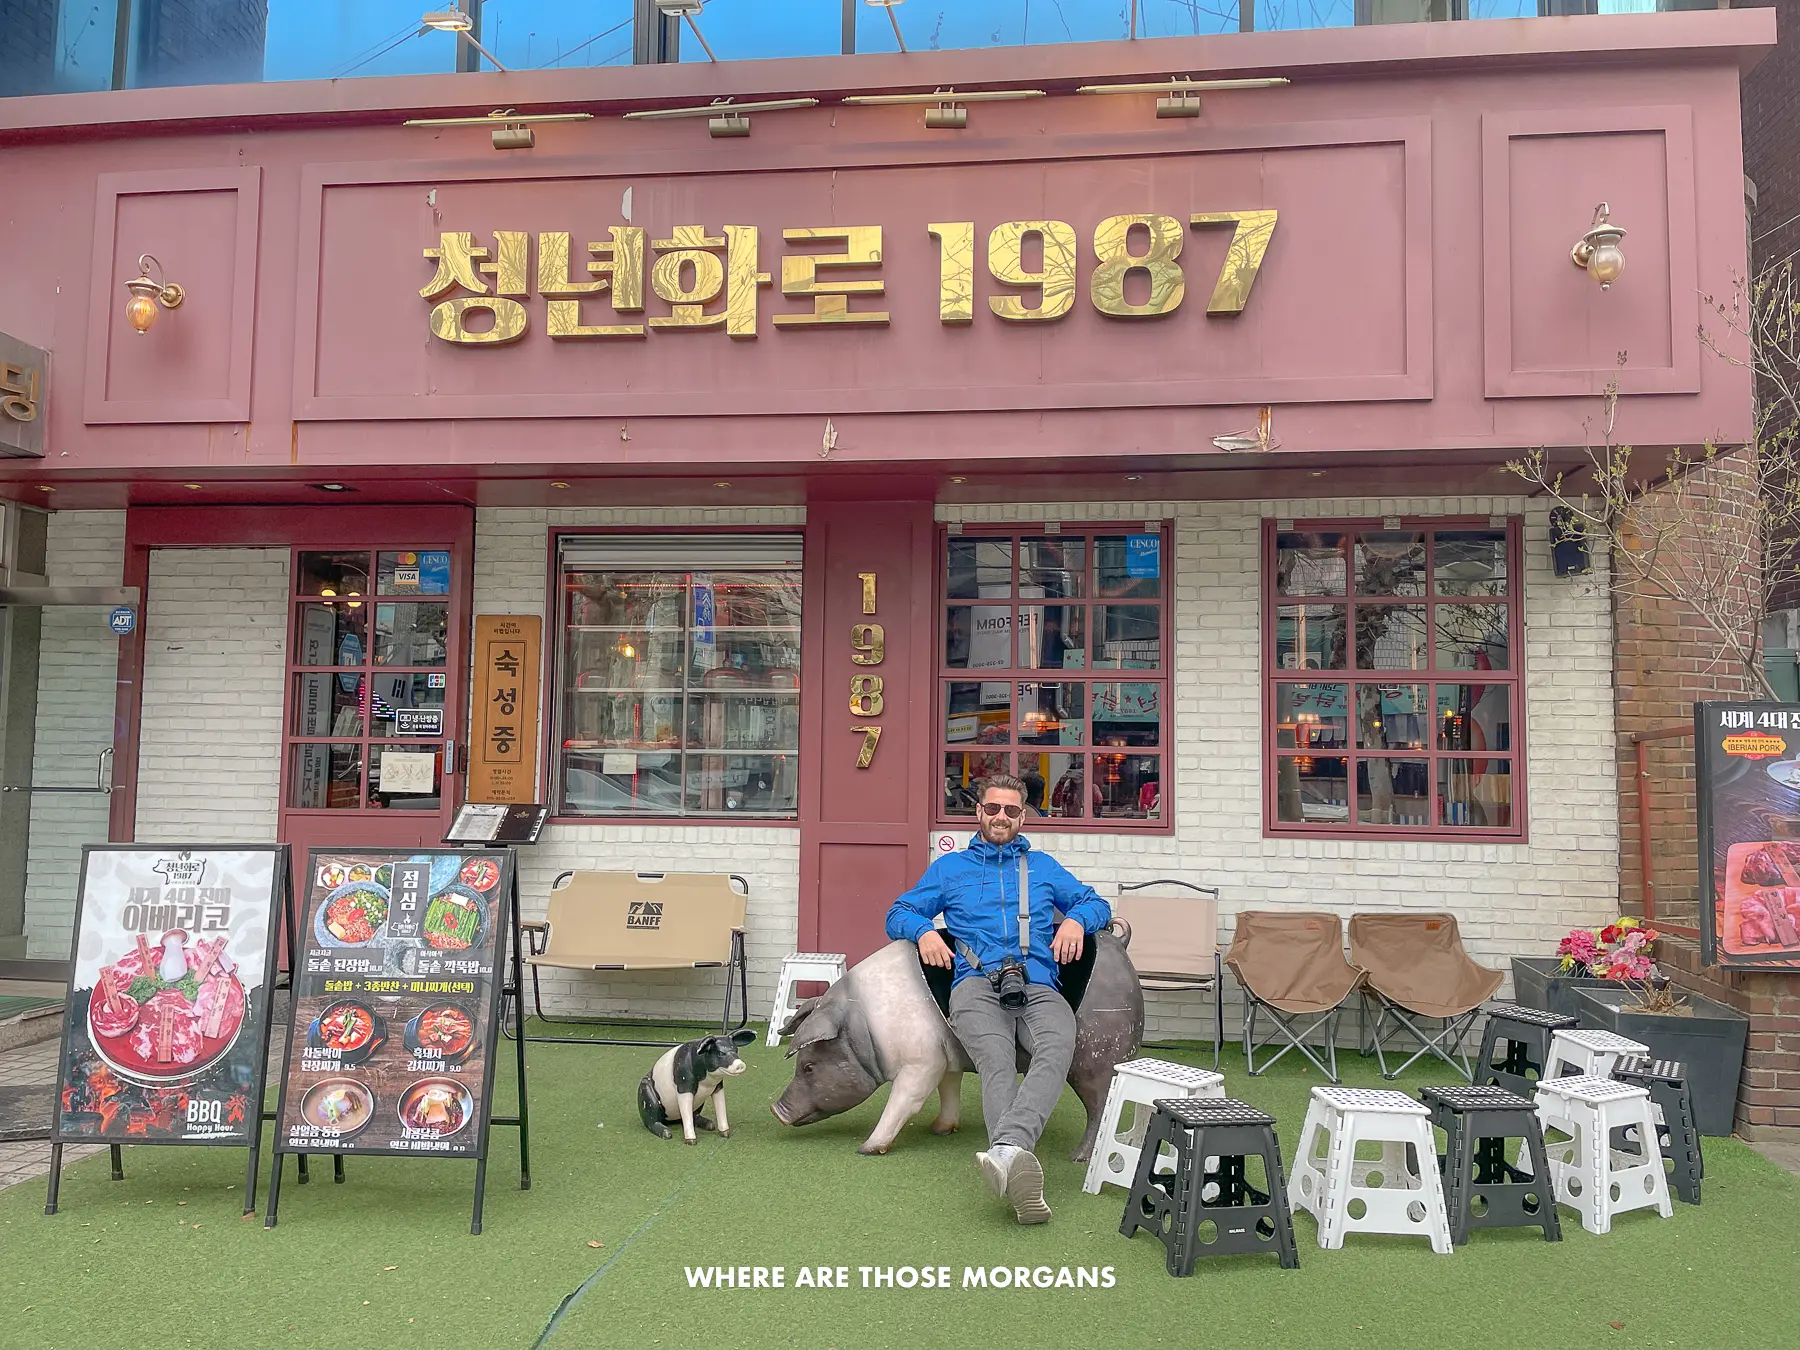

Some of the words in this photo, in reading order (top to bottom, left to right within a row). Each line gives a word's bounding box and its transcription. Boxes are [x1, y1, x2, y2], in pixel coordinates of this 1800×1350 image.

[418, 224, 890, 345] 청년화로
[929, 209, 1278, 324] 1987
[1130, 539, 1157, 549] CESCO
[423, 555, 448, 565] CESCO
[112, 615, 132, 626] ADT
[849, 572, 885, 769] 1987
[491, 650, 520, 754] 숙성중
[1719, 711, 1754, 729] 세계
[1756, 712, 1788, 729] 4대
[1759, 744, 1781, 752] PORK
[173, 872, 193, 880] 1987
[400, 870, 420, 911] 점심
[122, 904, 230, 933] 이베리코
[627, 915, 662, 925] BANFF
[334, 958, 370, 973] 된장밥
[301, 1060, 341, 1072] 된장찌개
[407, 1060, 445, 1072] 김치찌개
[187, 1099, 222, 1123] BBQ
[186, 1123, 213, 1133] Happy
[214, 1123, 234, 1132] Hour
